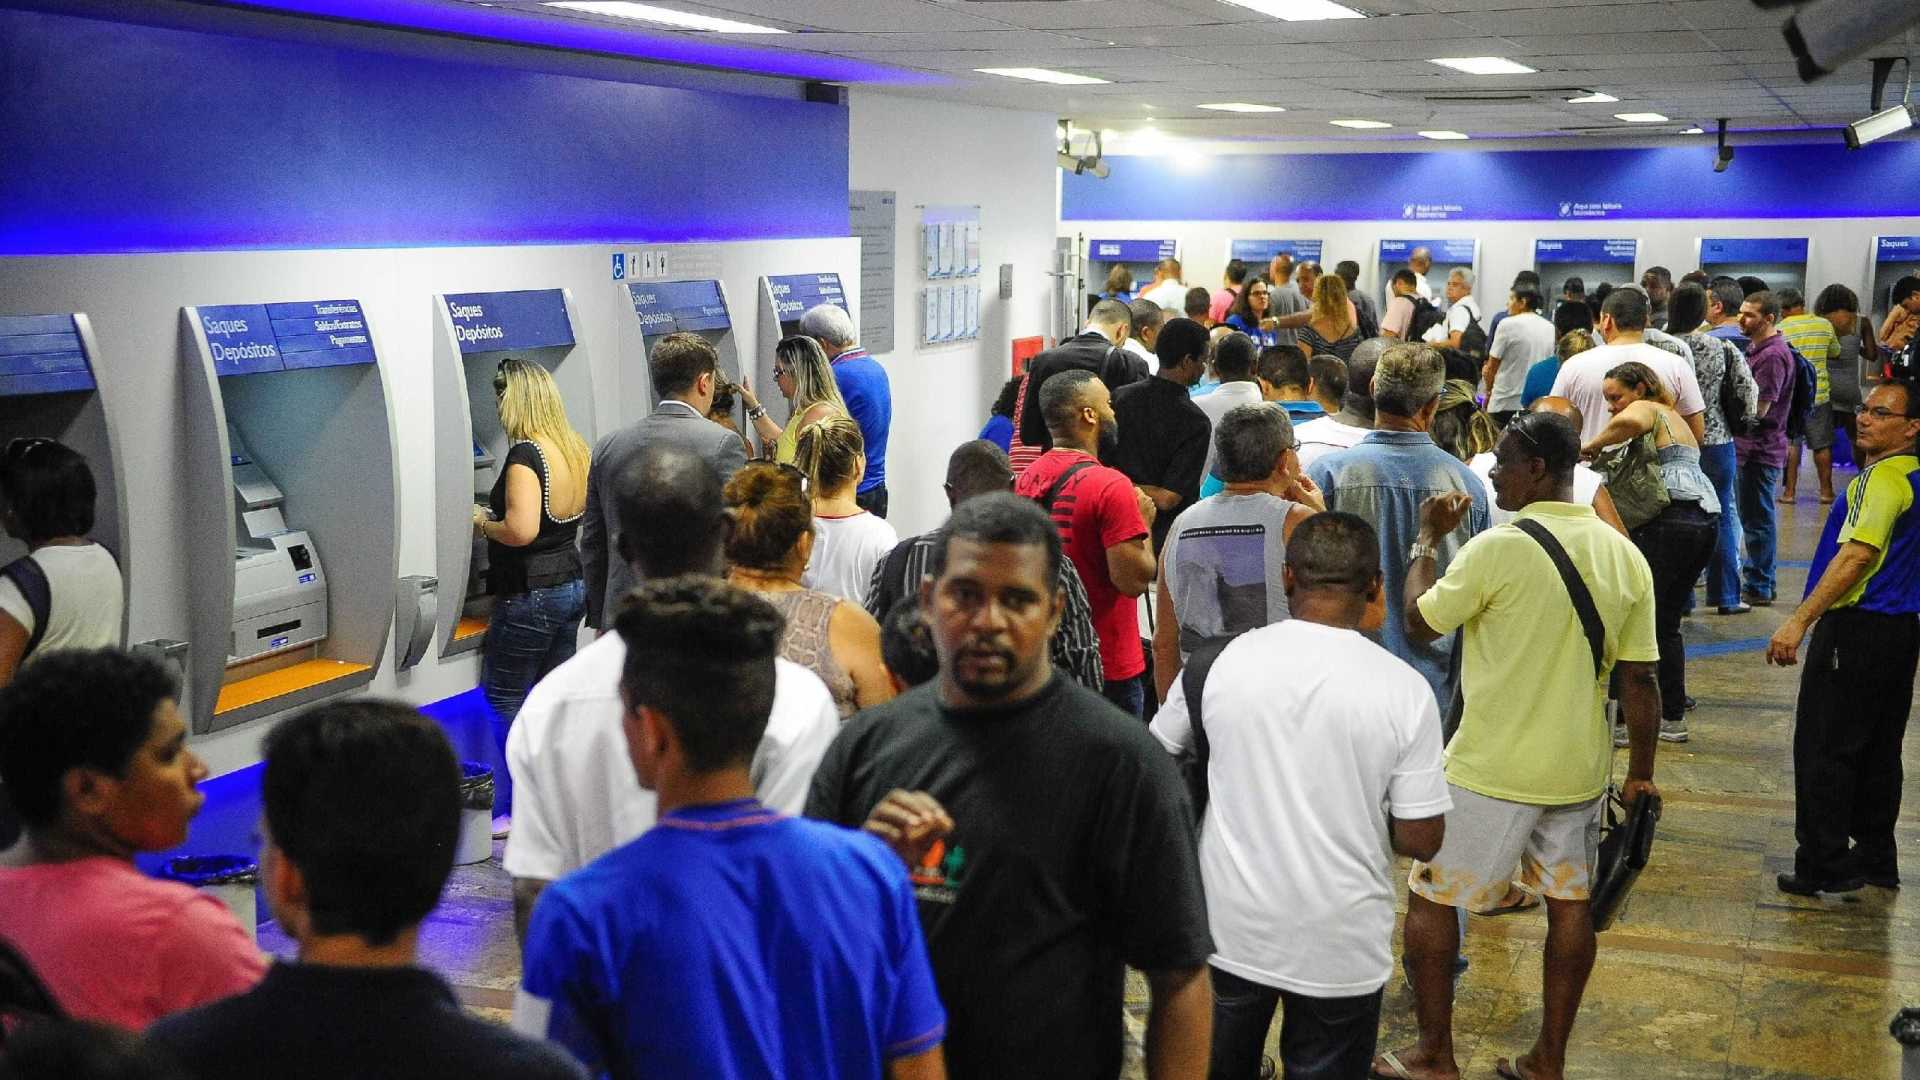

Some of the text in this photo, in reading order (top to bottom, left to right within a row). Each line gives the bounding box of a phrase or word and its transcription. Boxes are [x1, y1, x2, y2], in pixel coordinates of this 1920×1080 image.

[1880, 239, 1909, 249] Saques
[631, 291, 657, 308] Saques
[450, 301, 484, 321] Saques
[636, 312, 673, 328] Depósitos
[203, 316, 249, 339] Saques
[455, 324, 504, 344] Depósitos
[211, 341, 277, 365] Depósitos
